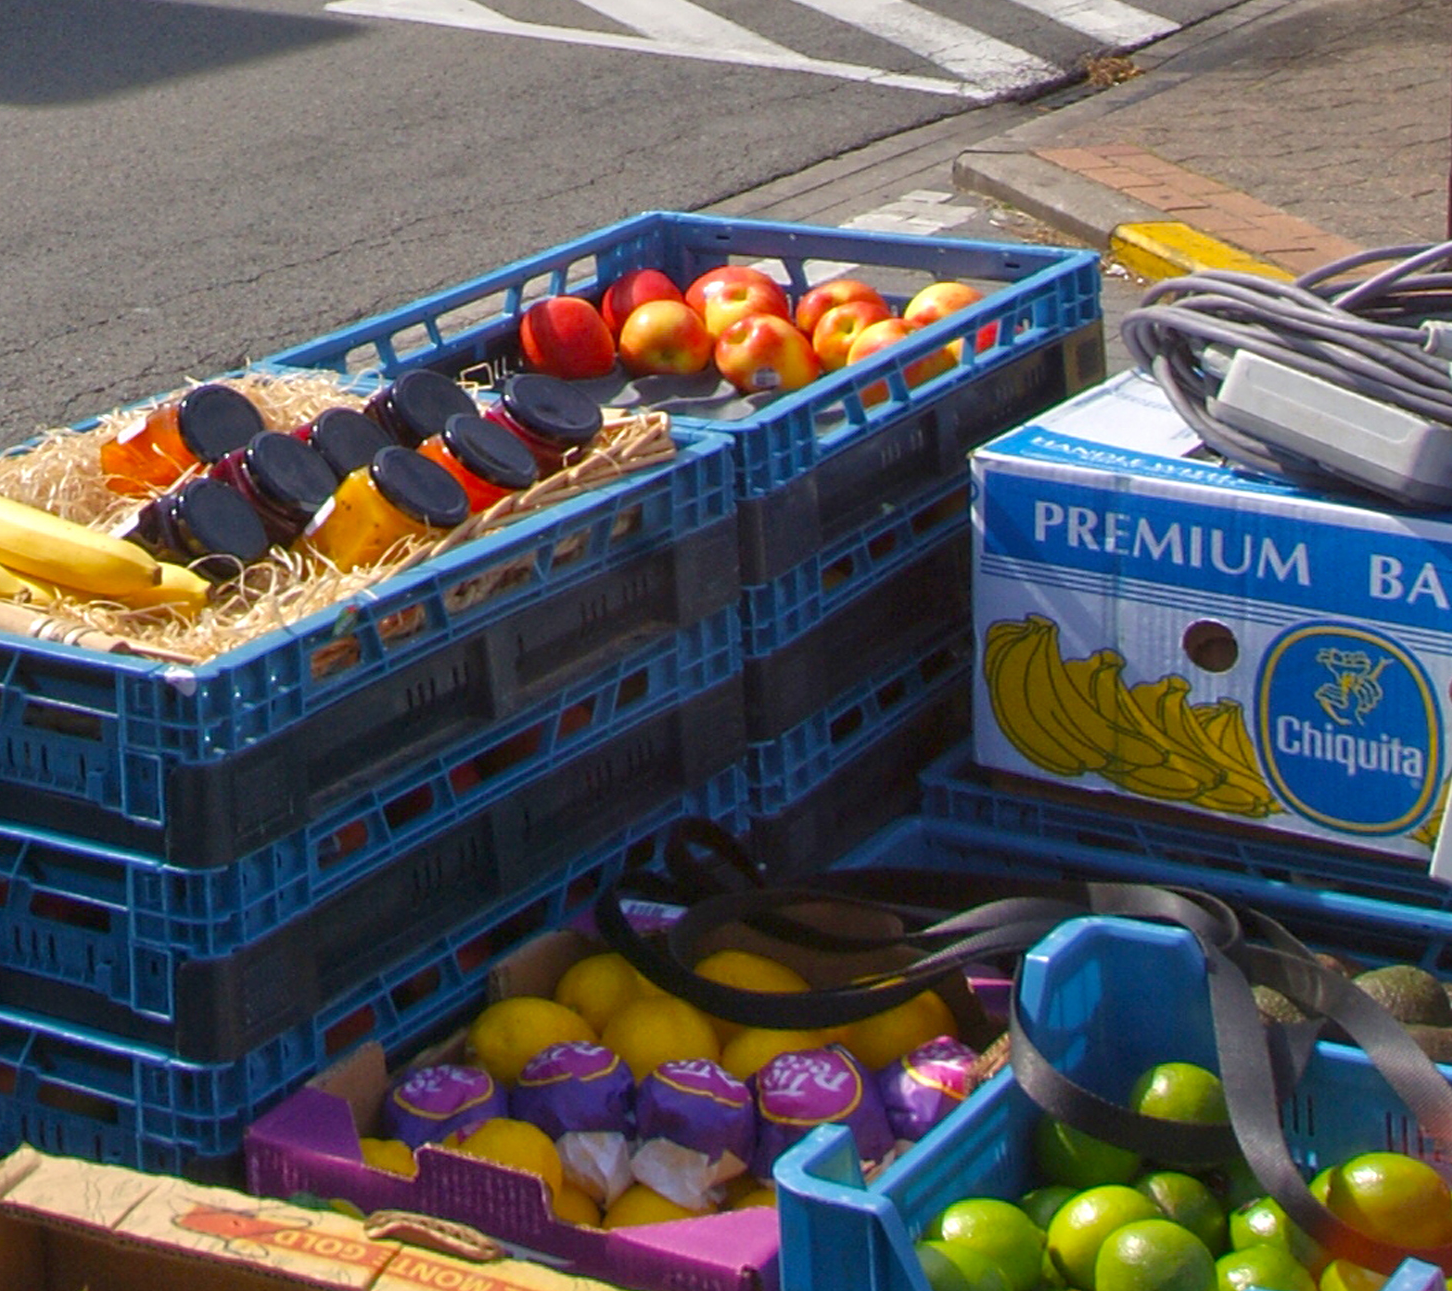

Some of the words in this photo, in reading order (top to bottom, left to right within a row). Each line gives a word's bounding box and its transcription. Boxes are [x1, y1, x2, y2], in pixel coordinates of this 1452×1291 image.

[1029, 435, 1143, 468] HANDLE
[1034, 499, 1311, 587] PREMIUM
[1277, 715, 1424, 778] Chiquita
[273, 1229, 367, 1261] GOLD
[371, 1239, 500, 1291] MONTE
